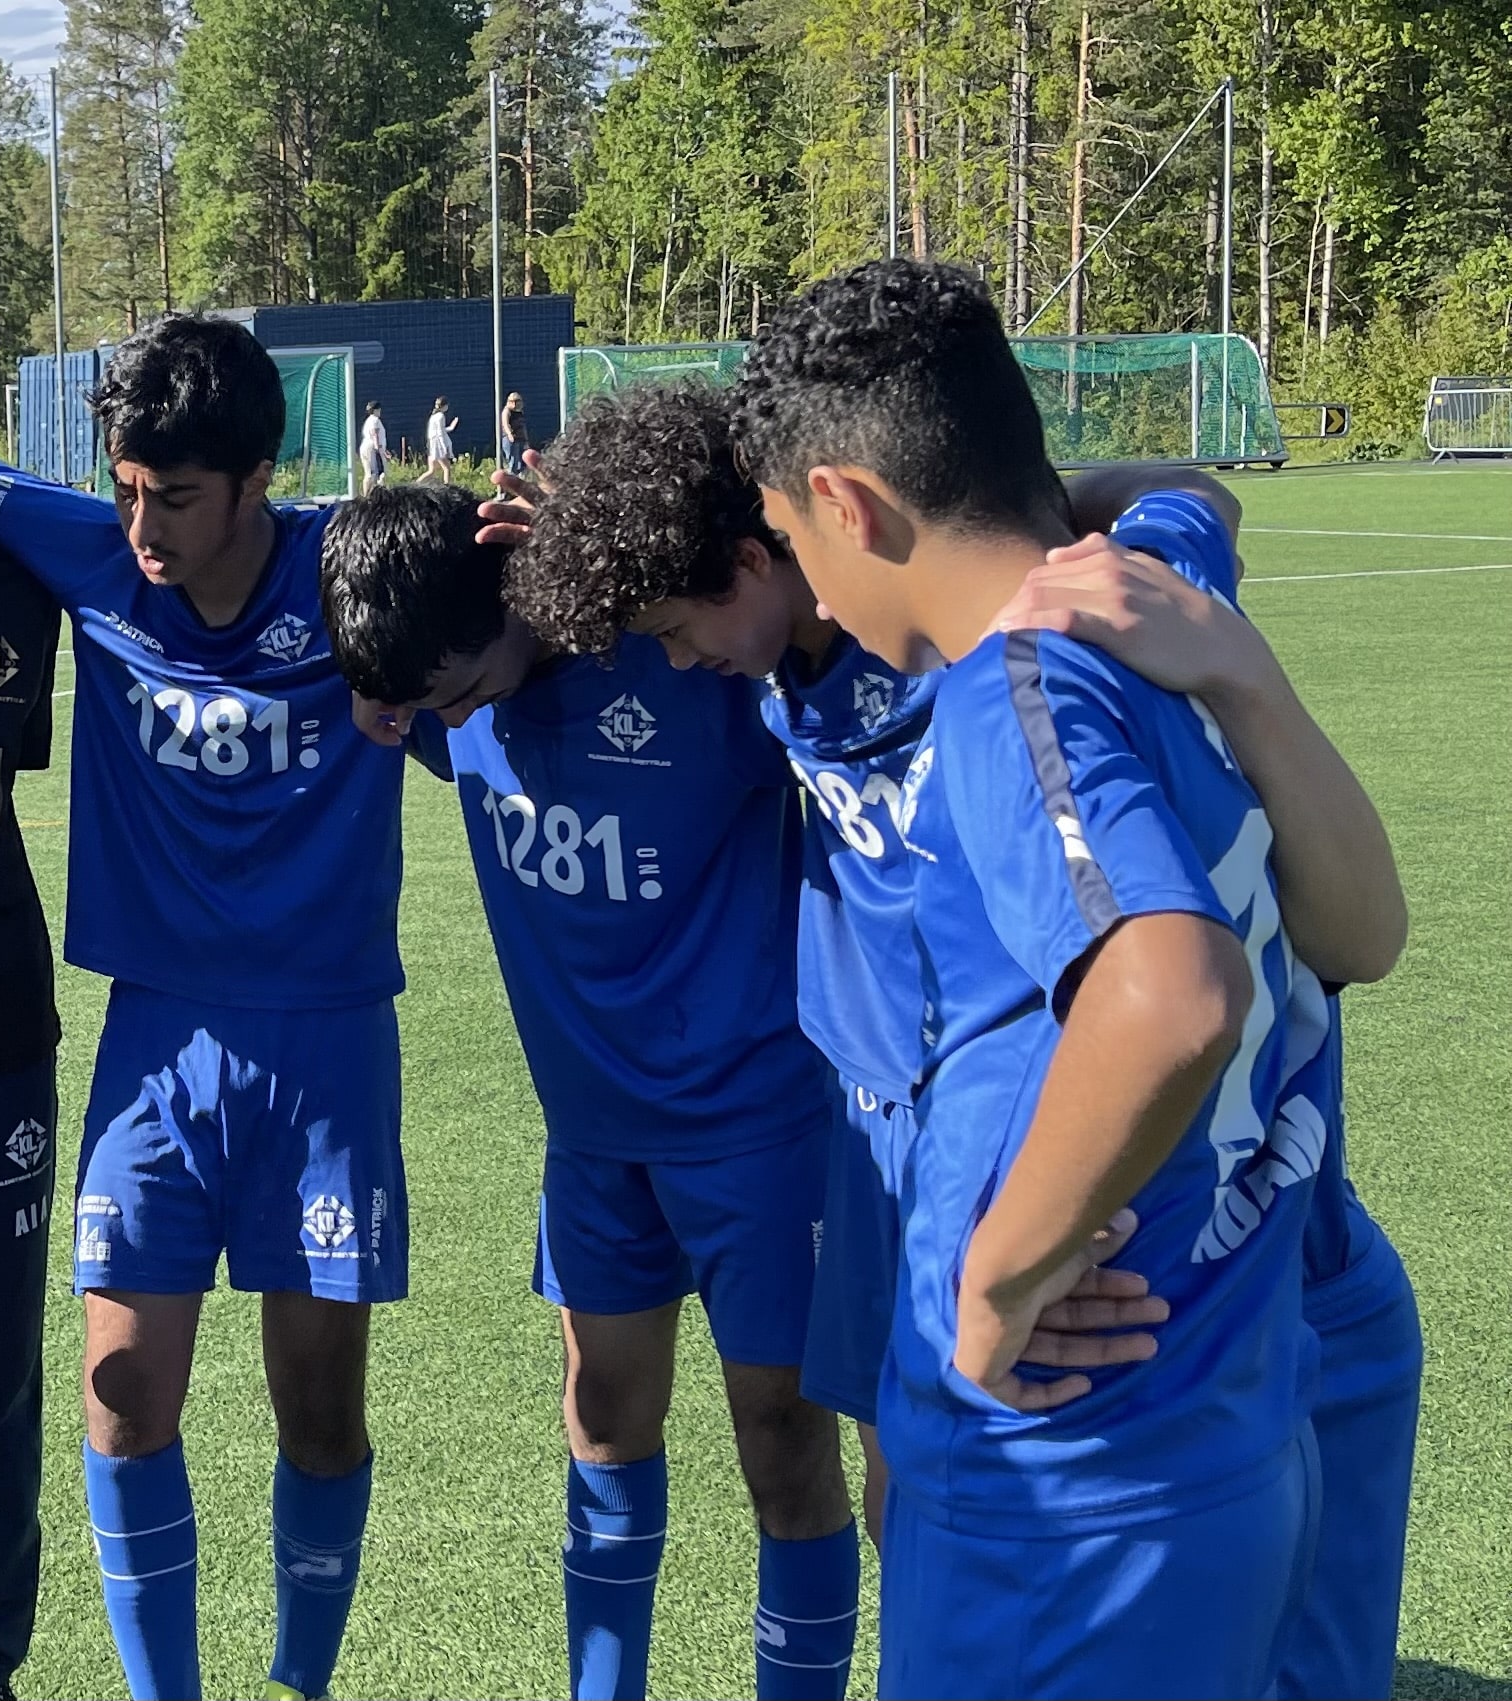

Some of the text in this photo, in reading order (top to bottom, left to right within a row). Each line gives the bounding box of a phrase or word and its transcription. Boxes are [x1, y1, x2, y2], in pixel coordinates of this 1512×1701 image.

[269, 626, 299, 651] KIL
[127, 682, 289, 776] 1281
[613, 712, 641, 736] KIL
[482, 786, 628, 902] 1281
[18, 1133, 38, 1156] KIL
[371, 1187, 383, 1248] PATRICK
